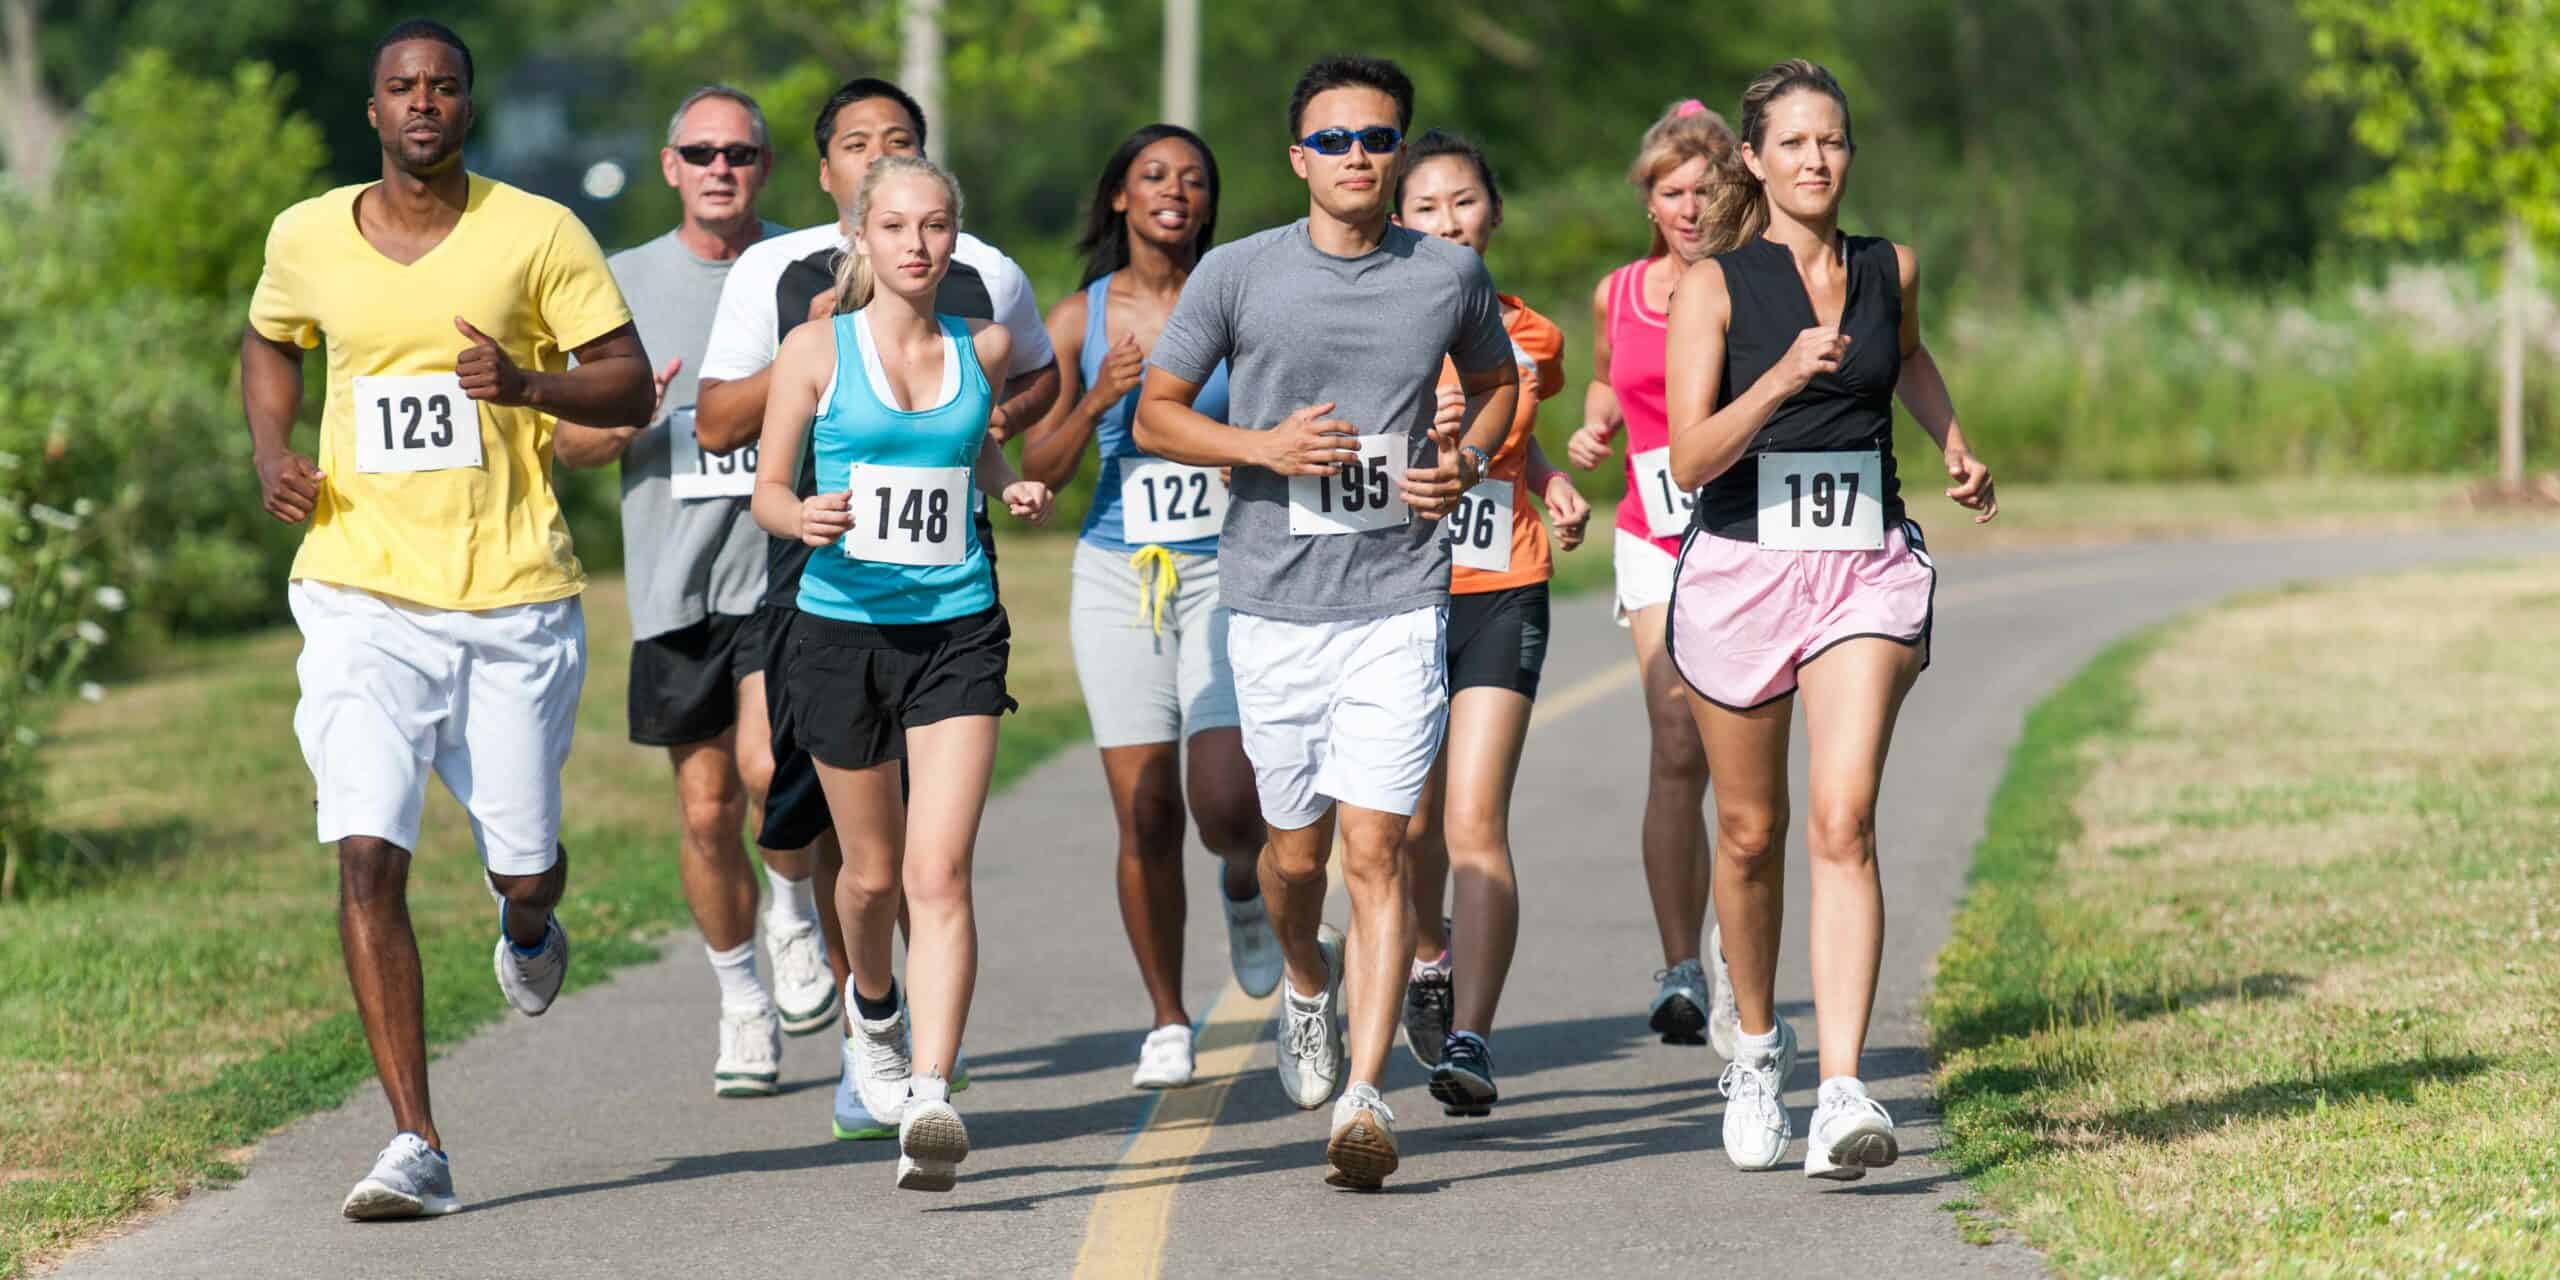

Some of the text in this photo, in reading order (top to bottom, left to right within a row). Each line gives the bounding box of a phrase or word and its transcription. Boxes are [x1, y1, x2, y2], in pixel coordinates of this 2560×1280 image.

[377, 394, 453, 450] 123
[1142, 472, 1211, 522] 122
[1313, 456, 1389, 512] 195
[1784, 472, 1859, 528] 197
[875, 487, 949, 543] 148
